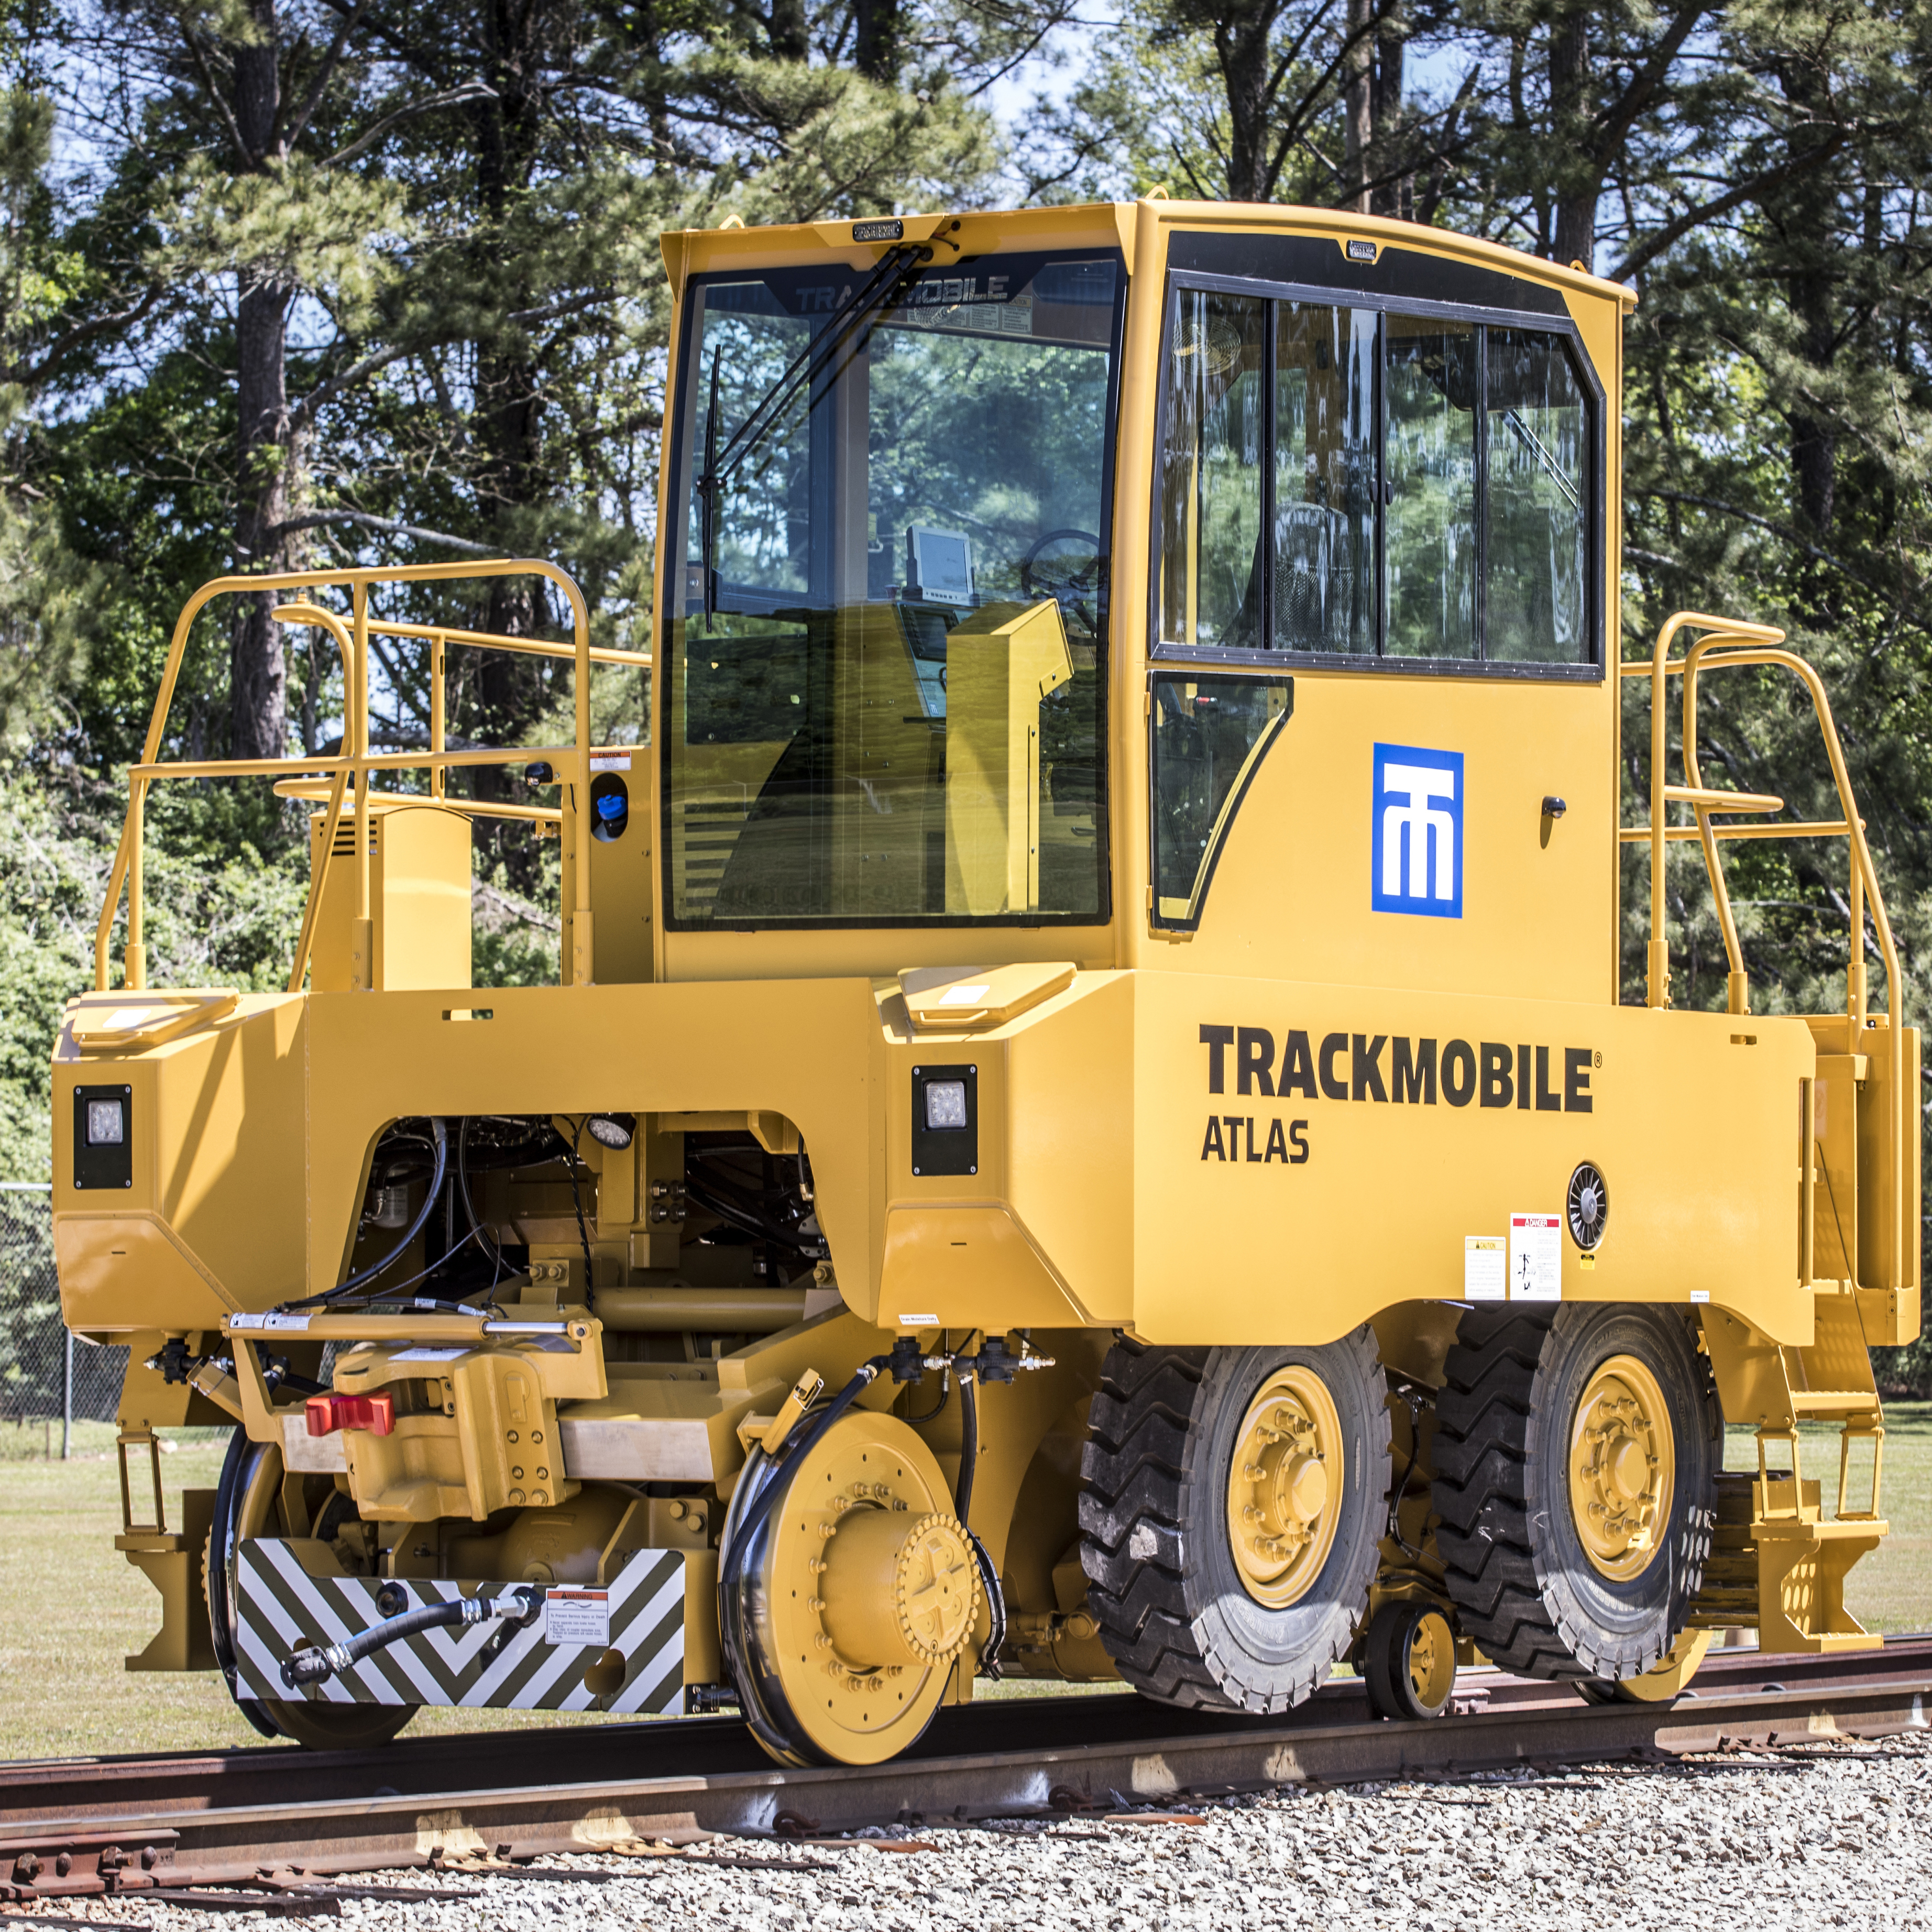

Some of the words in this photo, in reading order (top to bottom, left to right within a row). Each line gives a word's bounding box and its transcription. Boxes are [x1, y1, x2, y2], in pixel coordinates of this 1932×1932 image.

[795, 276, 1009, 311] TRAMOBILE
[1201, 1116, 1309, 1164] ATLAS
[1530, 1219, 1547, 1227] DANGER
[1480, 1242, 1496, 1250] CAUTION
